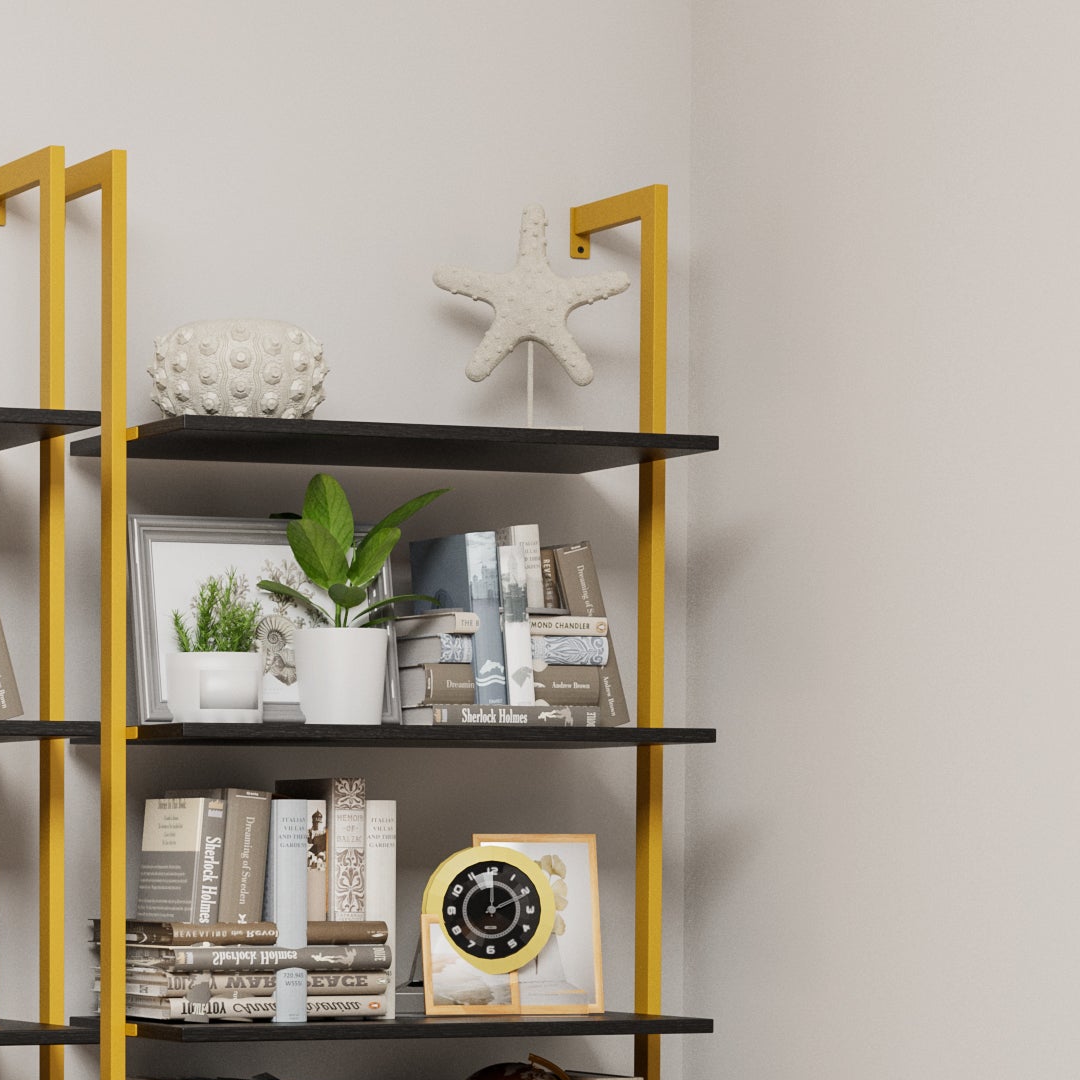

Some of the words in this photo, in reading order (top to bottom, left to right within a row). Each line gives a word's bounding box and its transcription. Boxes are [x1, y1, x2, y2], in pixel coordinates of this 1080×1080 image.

[576, 564, 590, 600] Dreaming
[461, 619, 473, 627] THE
[530, 621, 553, 629] MOND
[555, 621, 590, 630] CHANDLER
[446, 679, 474, 688] Dreamin
[551, 681, 572, 689] Andrew
[573, 681, 590, 689] Brown
[461, 708, 496, 723] Sherlock
[498, 708, 528, 724] Holmes
[239, 816, 256, 859] Dreaming
[202, 836, 222, 882] Sherlock
[243, 860, 252, 872] of
[486, 867, 498, 876] 12
[238, 871, 250, 905] Sweden
[452, 884, 464, 898] 10
[520, 886, 530, 896] 2
[198, 885, 218, 925] Holmes
[526, 905, 535, 914] 3
[446, 906, 457, 915] 9
[452, 925, 463, 936] 8
[522, 924, 531, 932] 4
[507, 939, 518, 948] 5
[486, 945, 496, 954] 6
